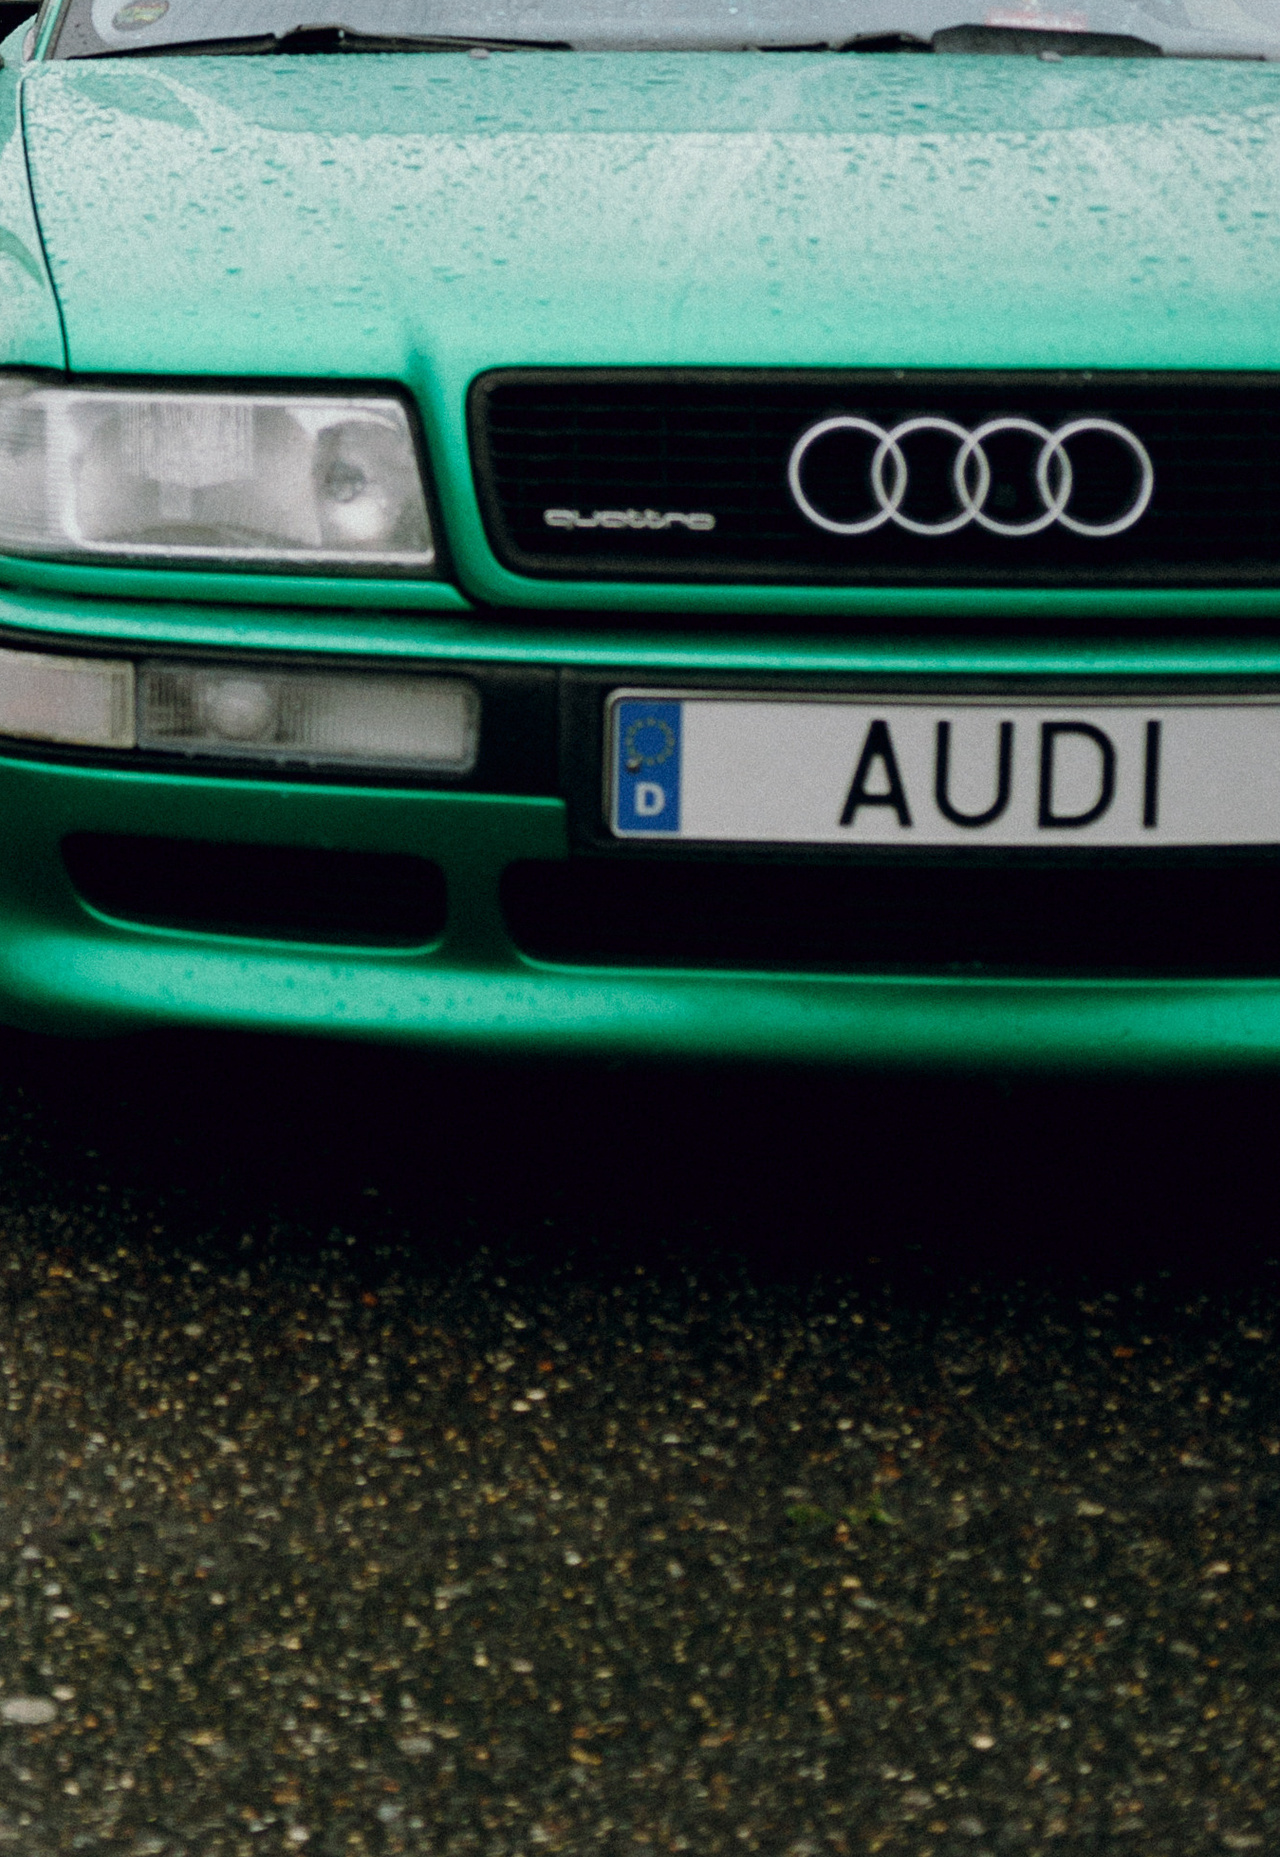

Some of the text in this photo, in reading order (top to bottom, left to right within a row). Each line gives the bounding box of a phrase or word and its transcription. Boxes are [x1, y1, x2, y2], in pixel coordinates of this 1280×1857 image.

[543, 508, 716, 531] quattro
[839, 719, 1161, 828] AUDI
[635, 783, 665, 815] D
